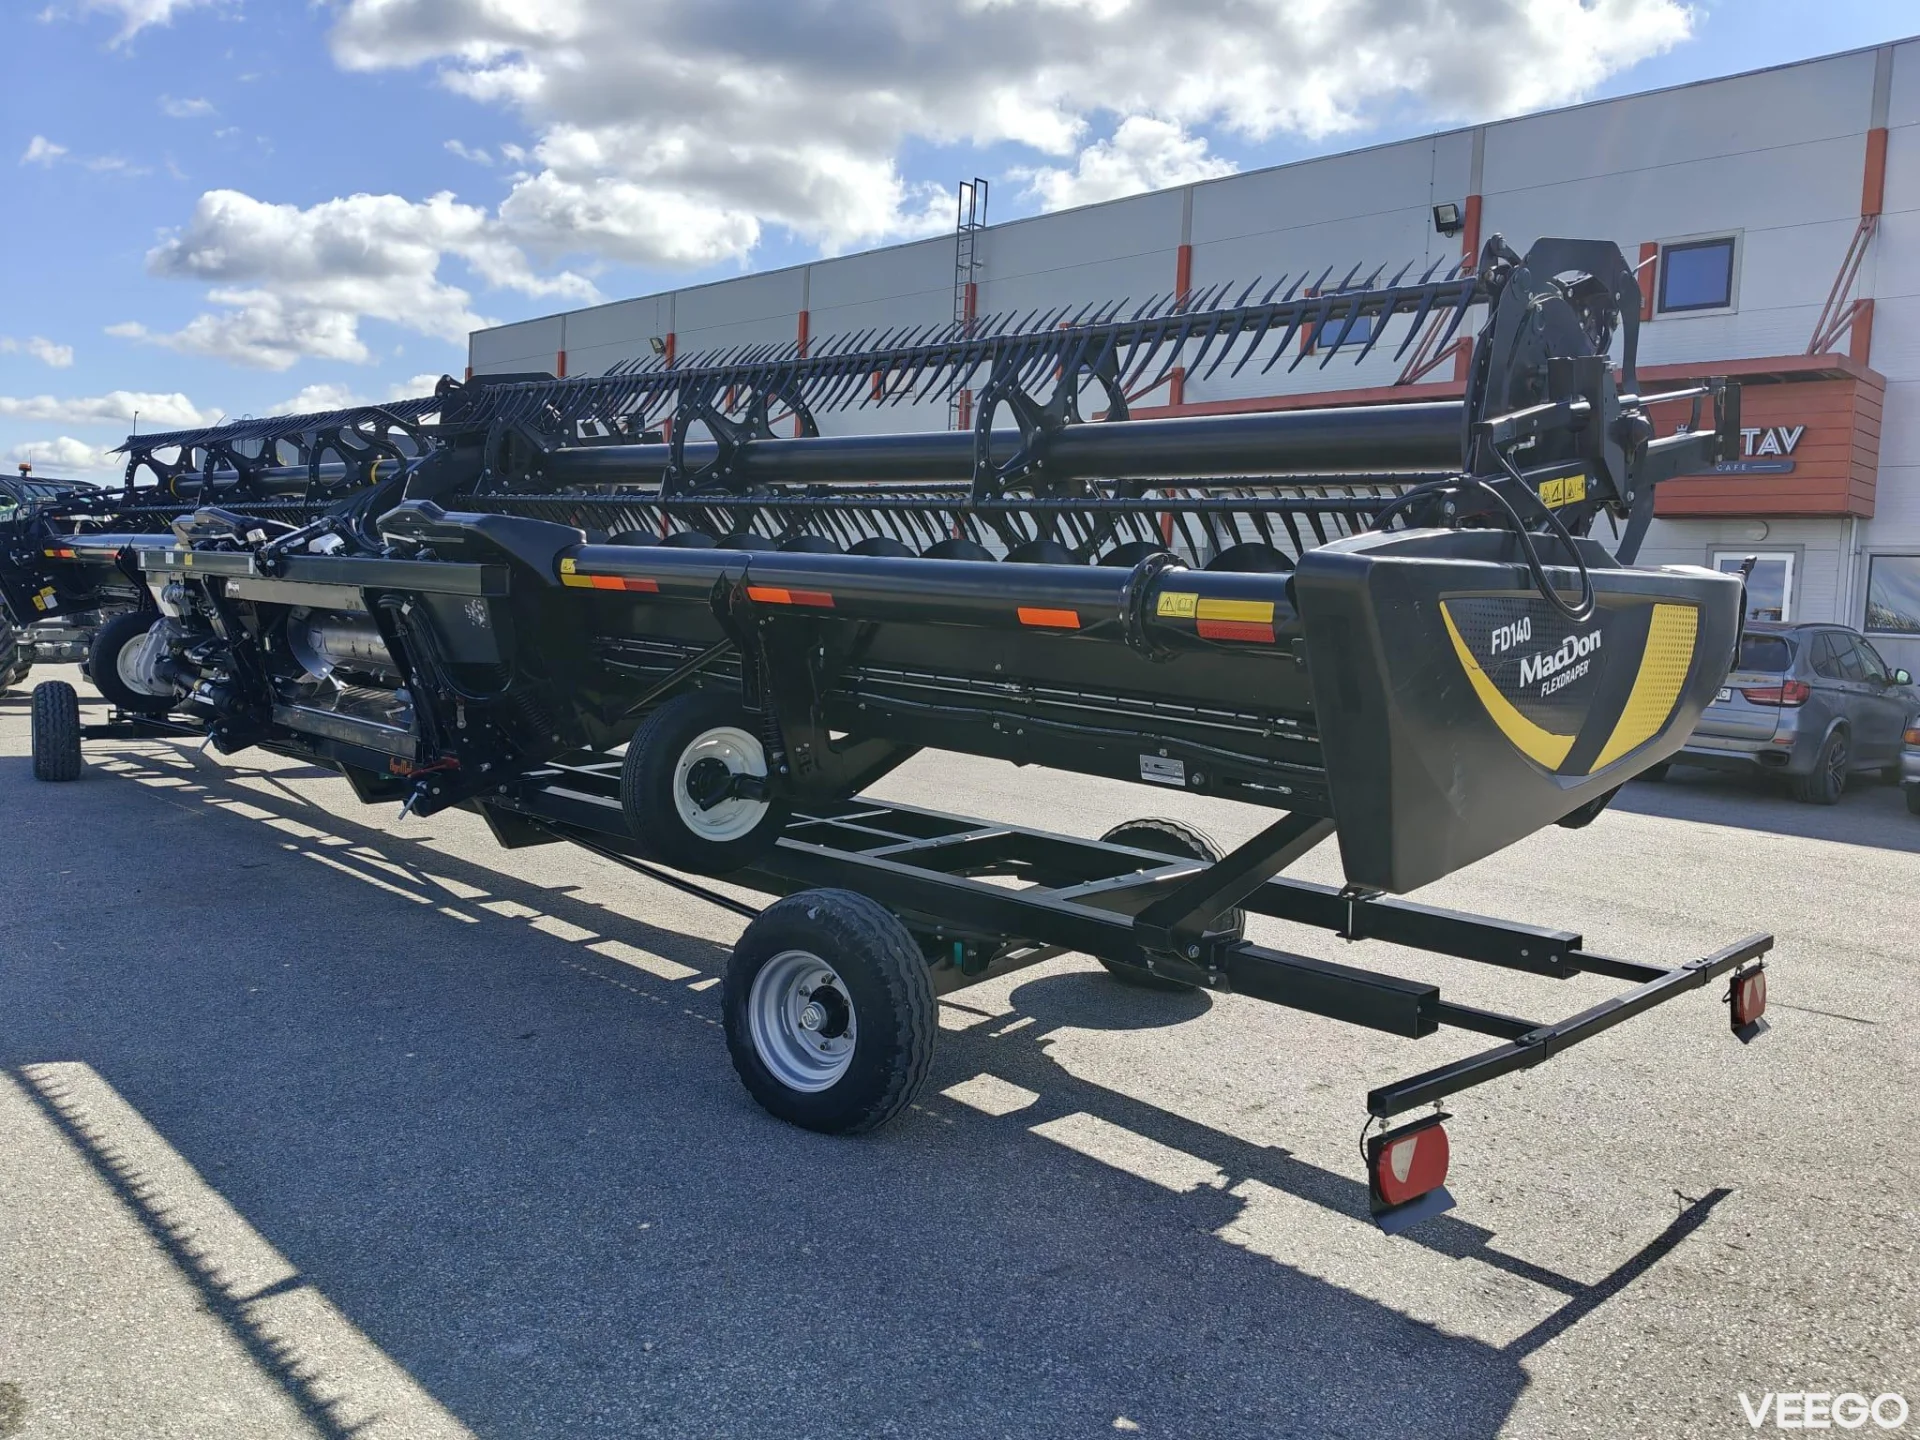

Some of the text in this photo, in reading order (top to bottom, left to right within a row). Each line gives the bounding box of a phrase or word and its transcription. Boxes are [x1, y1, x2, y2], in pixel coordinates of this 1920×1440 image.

[1740, 425, 1804, 455] TAV
[1490, 616, 1532, 655] FD140
[1519, 630, 1601, 688] MacDon
[1540, 661, 1589, 698] FLEXDRAPER
